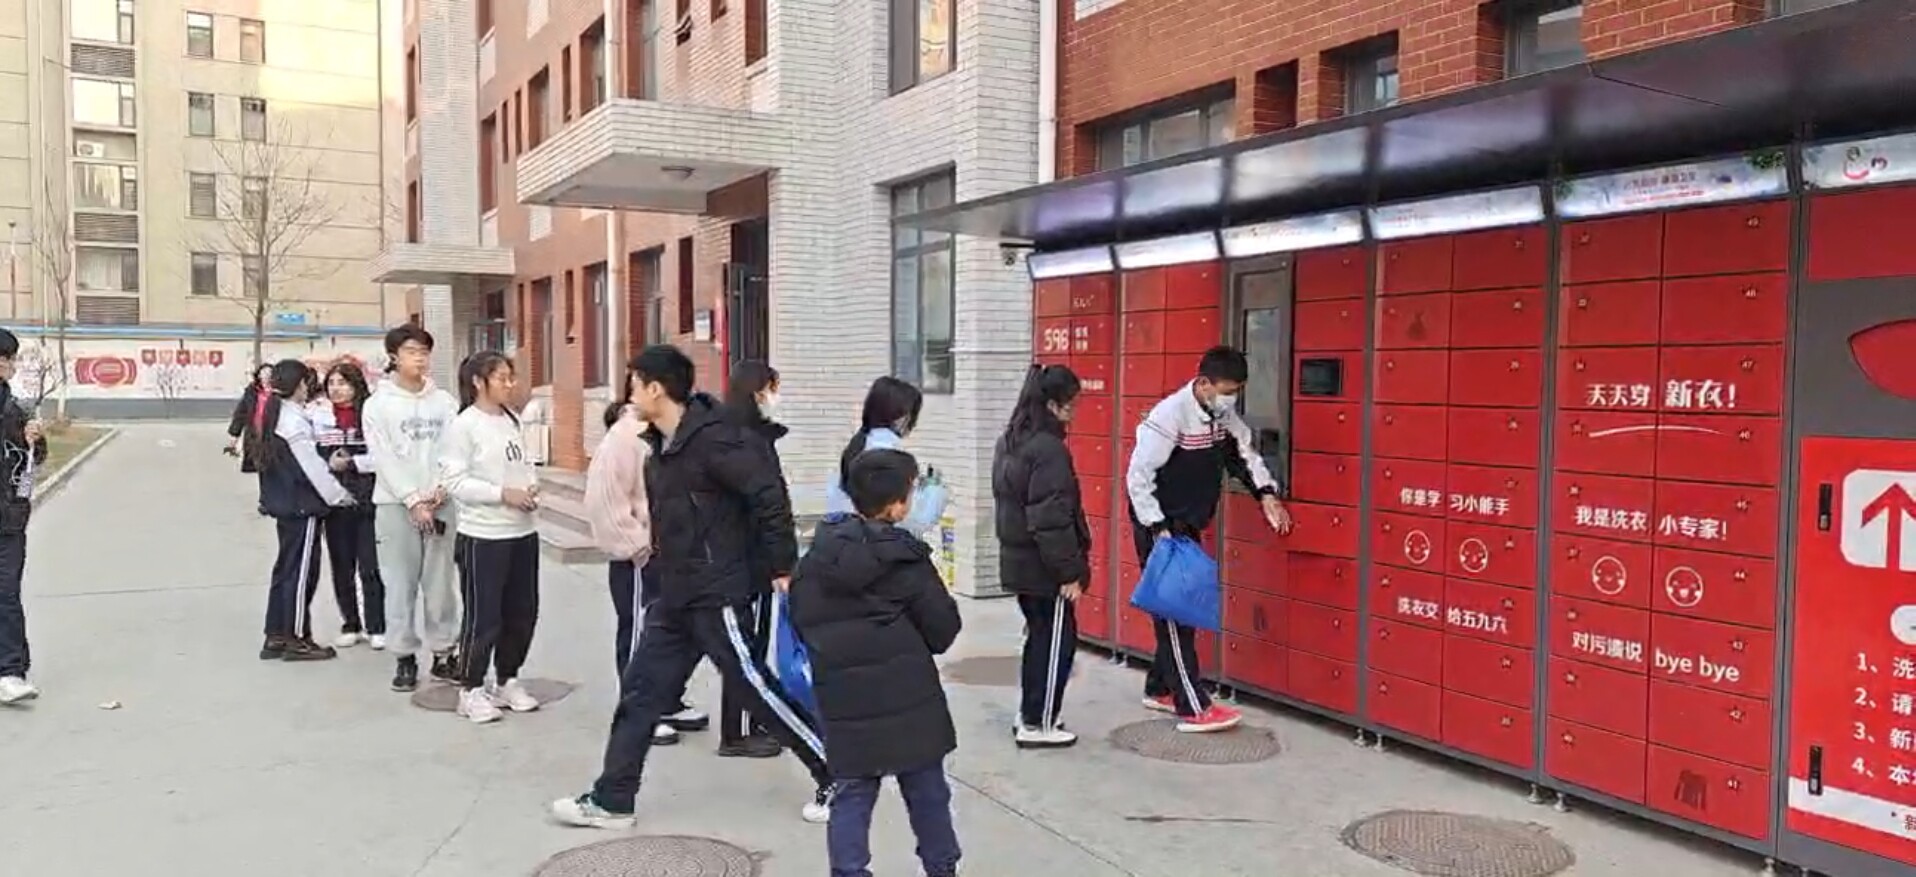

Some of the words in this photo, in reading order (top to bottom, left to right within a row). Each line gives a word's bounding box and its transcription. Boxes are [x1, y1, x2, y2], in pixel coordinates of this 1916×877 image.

[1586, 382, 1651, 407] 天天穿
[1574, 504, 1647, 531] 我是洗衣
[1658, 513, 1728, 541] 小专家!
[1571, 631, 1643, 662] 对污渍说
[1655, 649, 1693, 675] bye
[1699, 655, 1740, 683] bye
